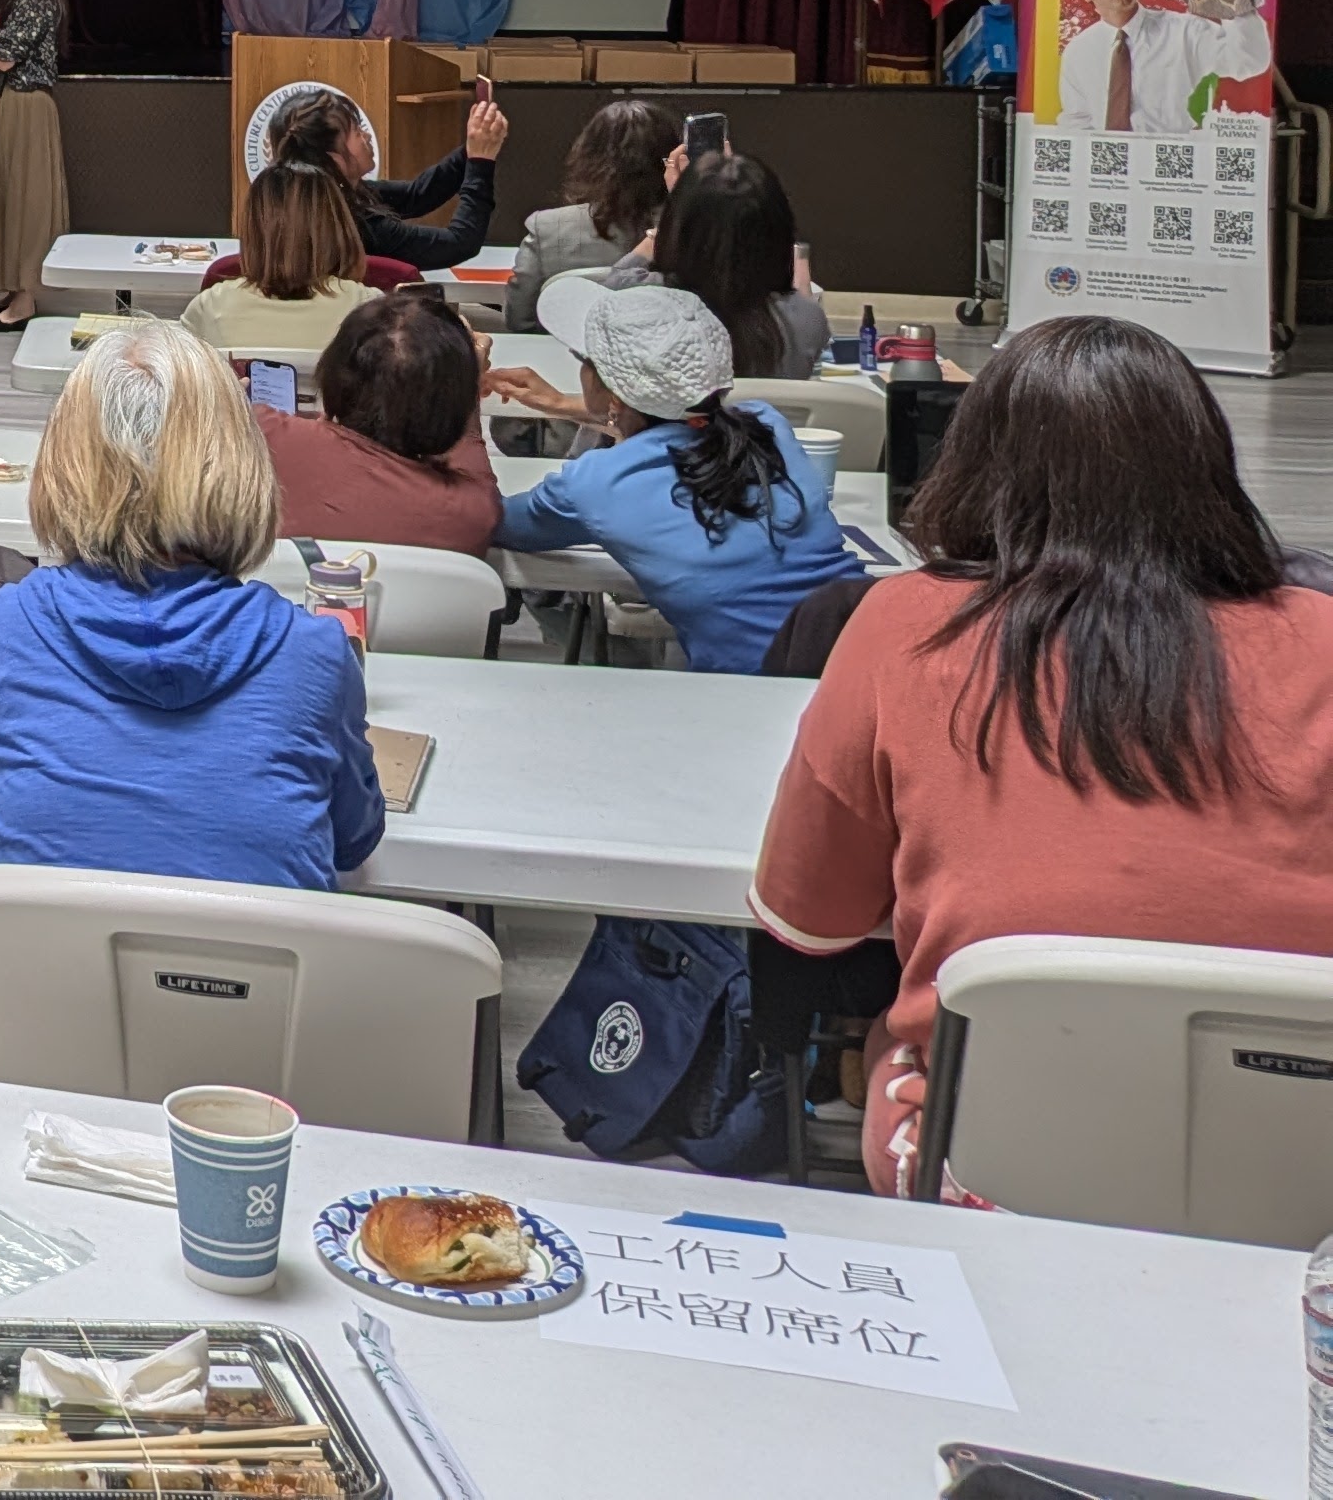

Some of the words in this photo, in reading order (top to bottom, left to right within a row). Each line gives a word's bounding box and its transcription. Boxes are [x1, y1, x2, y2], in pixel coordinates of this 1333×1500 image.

[247, 122, 263, 172] CULTURE
[256, 90, 290, 121] CENTER
[1210, 123, 1261, 131] DEMOCRATIC
[1217, 129, 1256, 138] TAIWAN
[167, 976, 237, 994] LIFETIME
[585, 1230, 915, 1302] 工作人員
[590, 1280, 940, 1362] 保留席位
